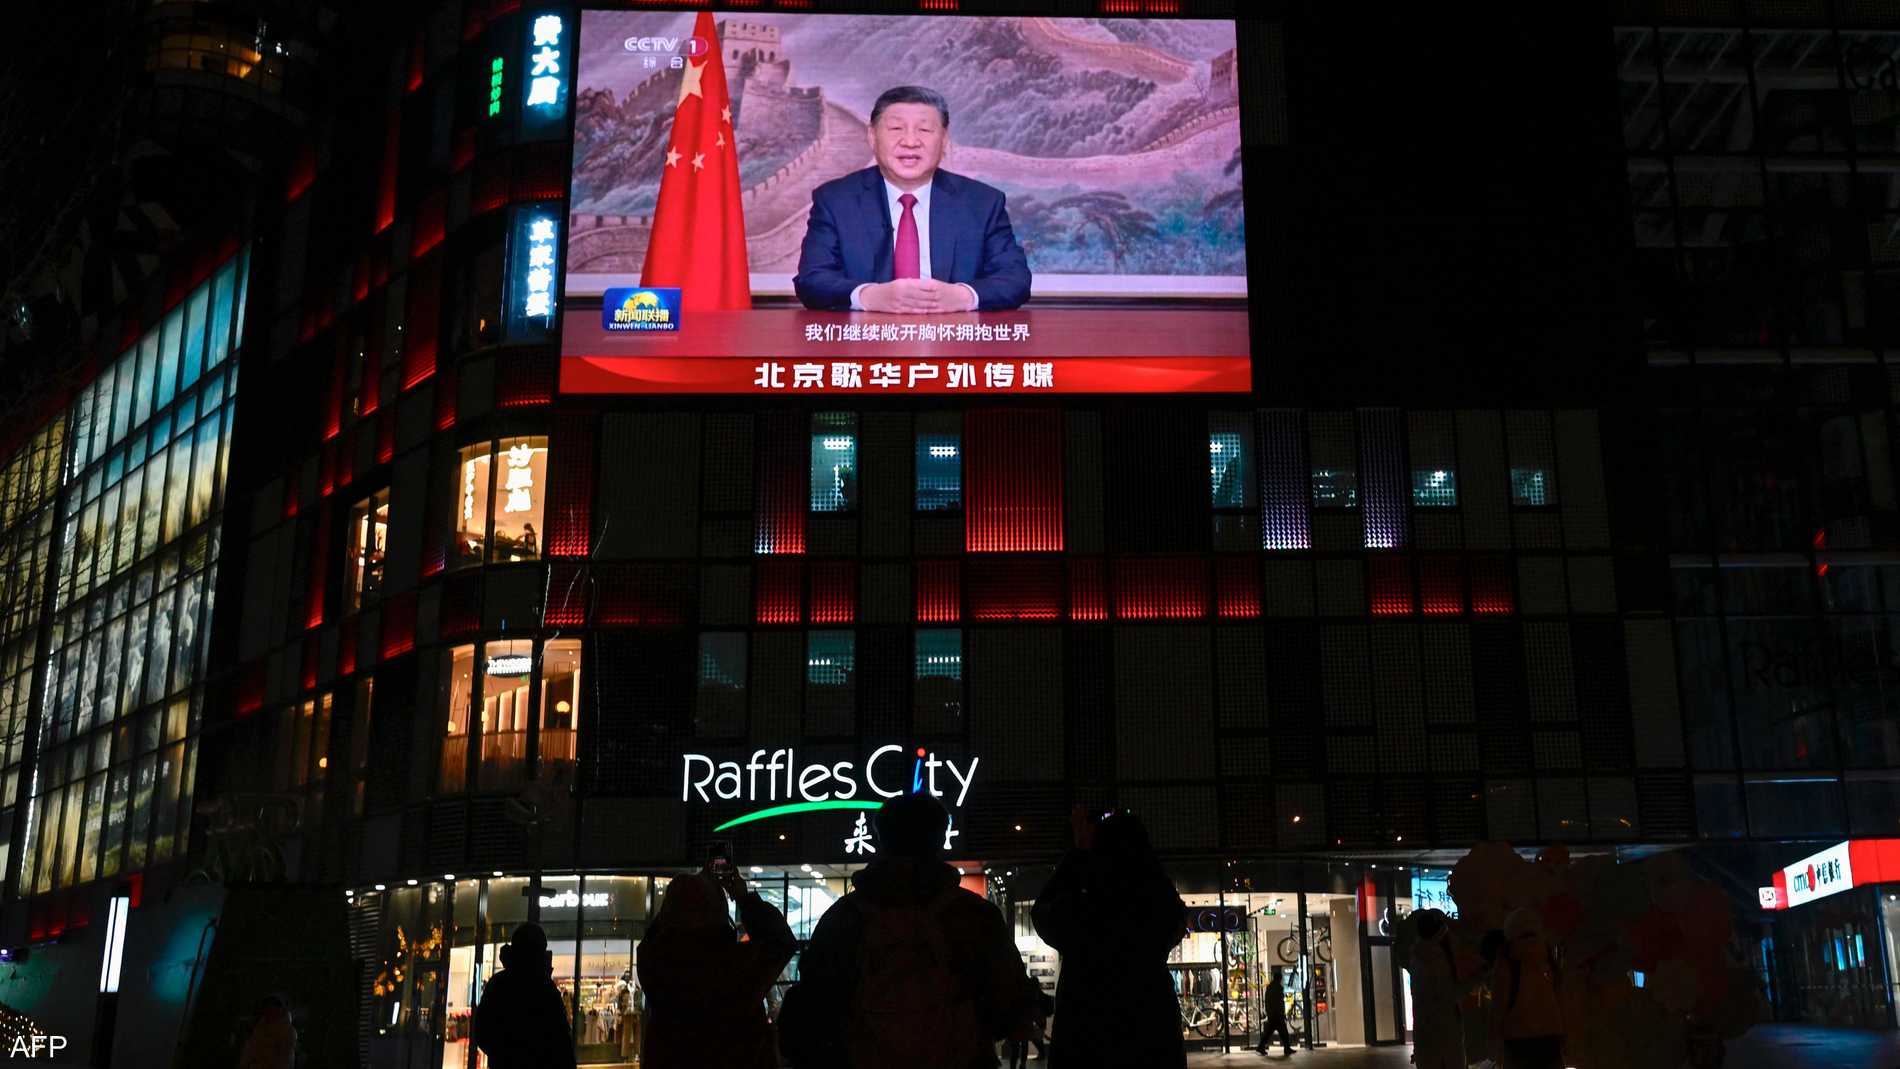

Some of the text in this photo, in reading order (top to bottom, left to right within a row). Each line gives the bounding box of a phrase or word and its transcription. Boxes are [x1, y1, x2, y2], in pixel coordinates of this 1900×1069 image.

[624, 37, 697, 54] CCTV 1
[805, 323, 1030, 342] 我们继续敞开胸怀拥抱世界
[754, 361, 1055, 388] 北京歌华户外传媒
[683, 744, 979, 807] Raffles City
